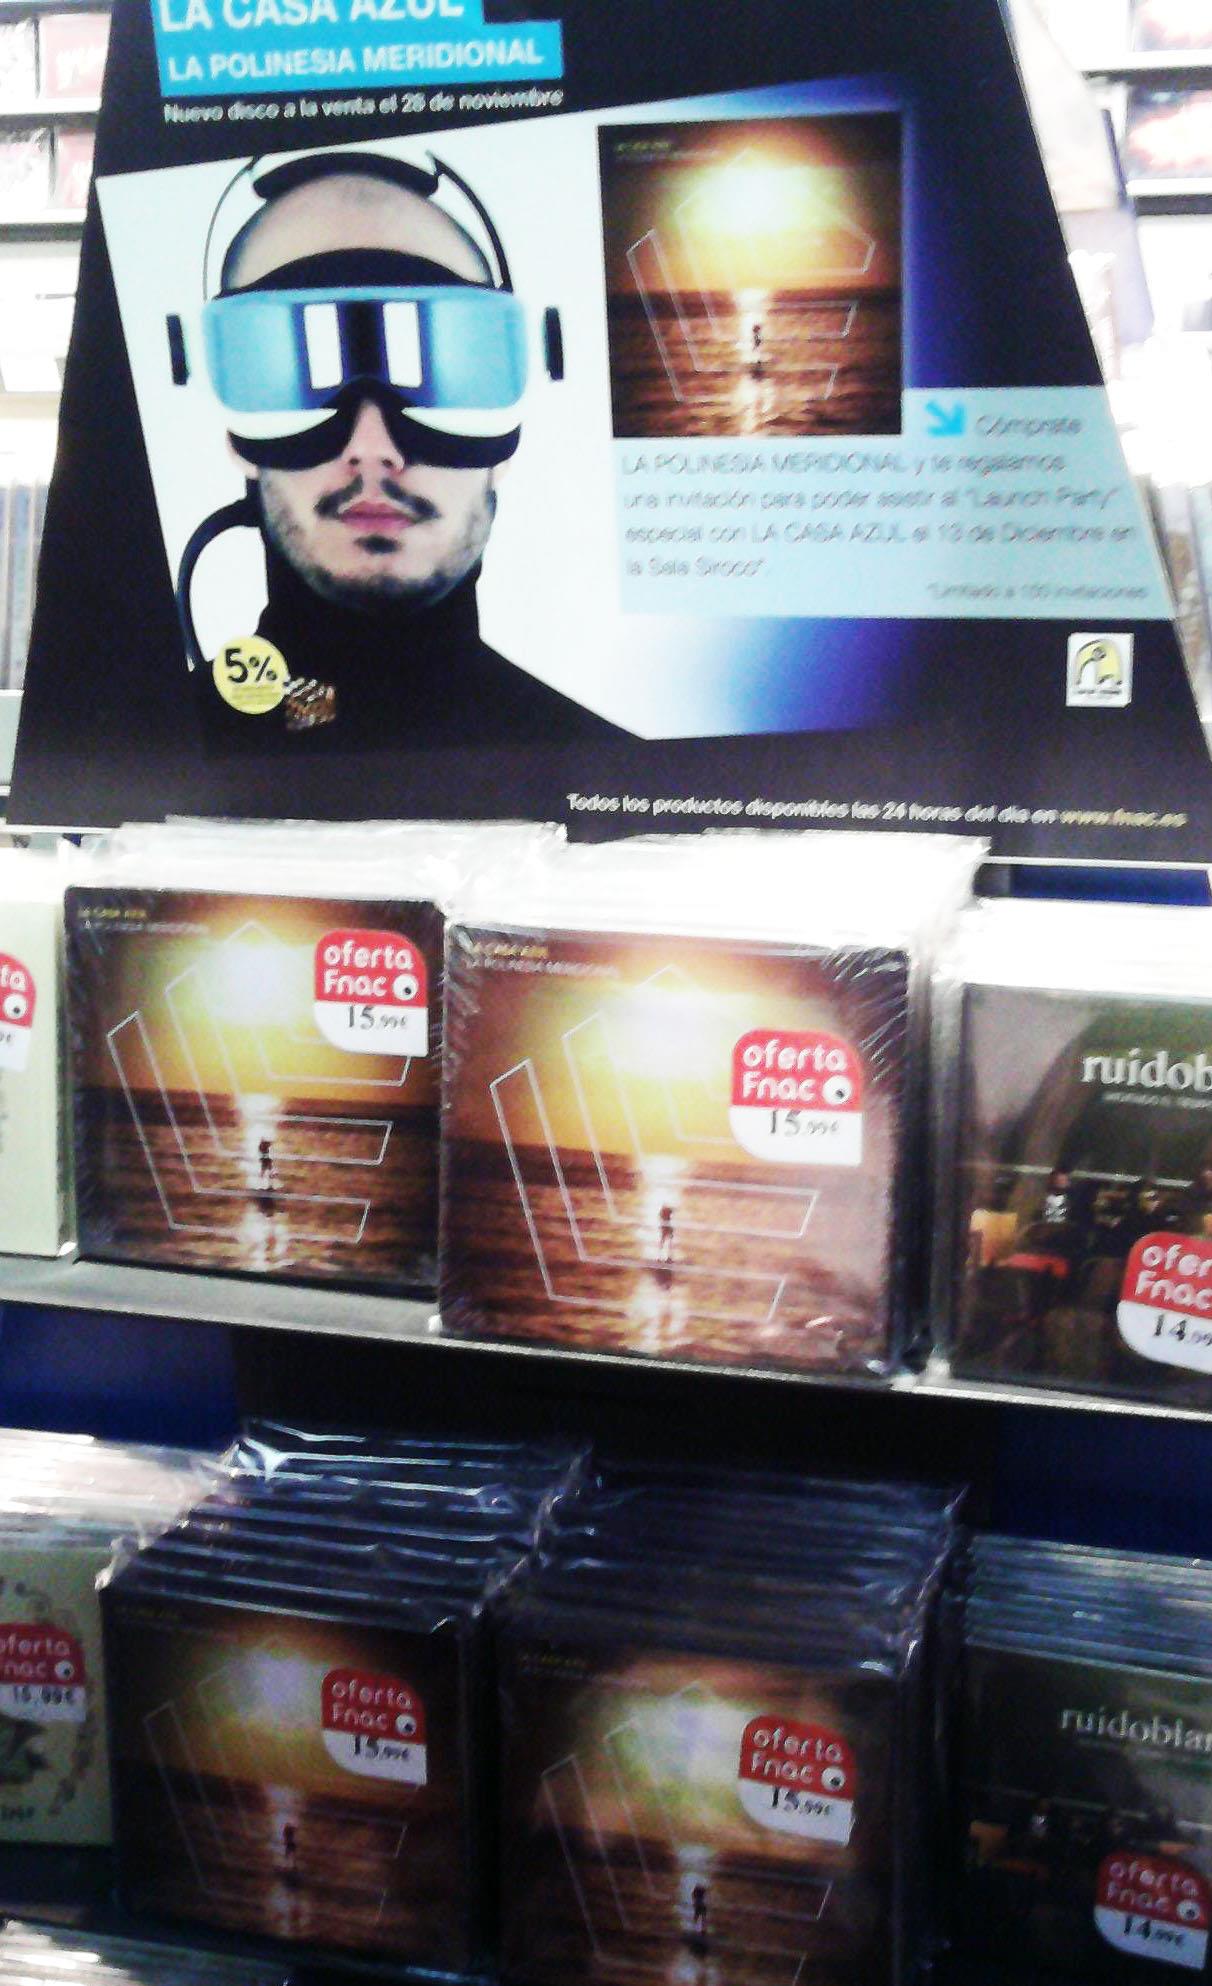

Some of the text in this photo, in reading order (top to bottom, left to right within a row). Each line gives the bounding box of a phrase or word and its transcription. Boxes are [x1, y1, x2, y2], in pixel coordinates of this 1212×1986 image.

[160, 0, 213, 32] LA
[223, 0, 338, 29] CASA
[168, 38, 544, 81] LA POLINESIA MERIDIONAL
[164, 103, 223, 122] Nuevo
[228, 101, 280, 120] disco
[283, 102, 297, 119] a
[300, 98, 318, 117] la
[322, 96, 376, 116] venta
[429, 91, 454, 112] de
[459, 86, 564, 111] noviembre
[622, 453, 649, 475] LA
[654, 451, 765, 475] POLINESIA
[770, 450, 909, 474] MERIDIONAL
[752, 522, 779, 544] LA
[783, 521, 845, 544] CASA
[849, 520, 909, 544] AZUL
[225, 648, 278, 683] 5%
[567, 793, 621, 813] Todos
[622, 795, 651, 812] los
[653, 797, 743, 817] productos
[745, 799, 850, 820] disponibles
[851, 800, 881, 819] las
[882, 801, 907, 820] 24
[908, 802, 963, 821] horas
[964, 804, 998, 823] del
[323, 939, 414, 970] oferta
[742, 1039, 848, 1073] oferta
[331, 1679, 412, 1710] oferta
[752, 1726, 844, 1763] oferta
[1109, 1860, 1199, 1898] oferta
